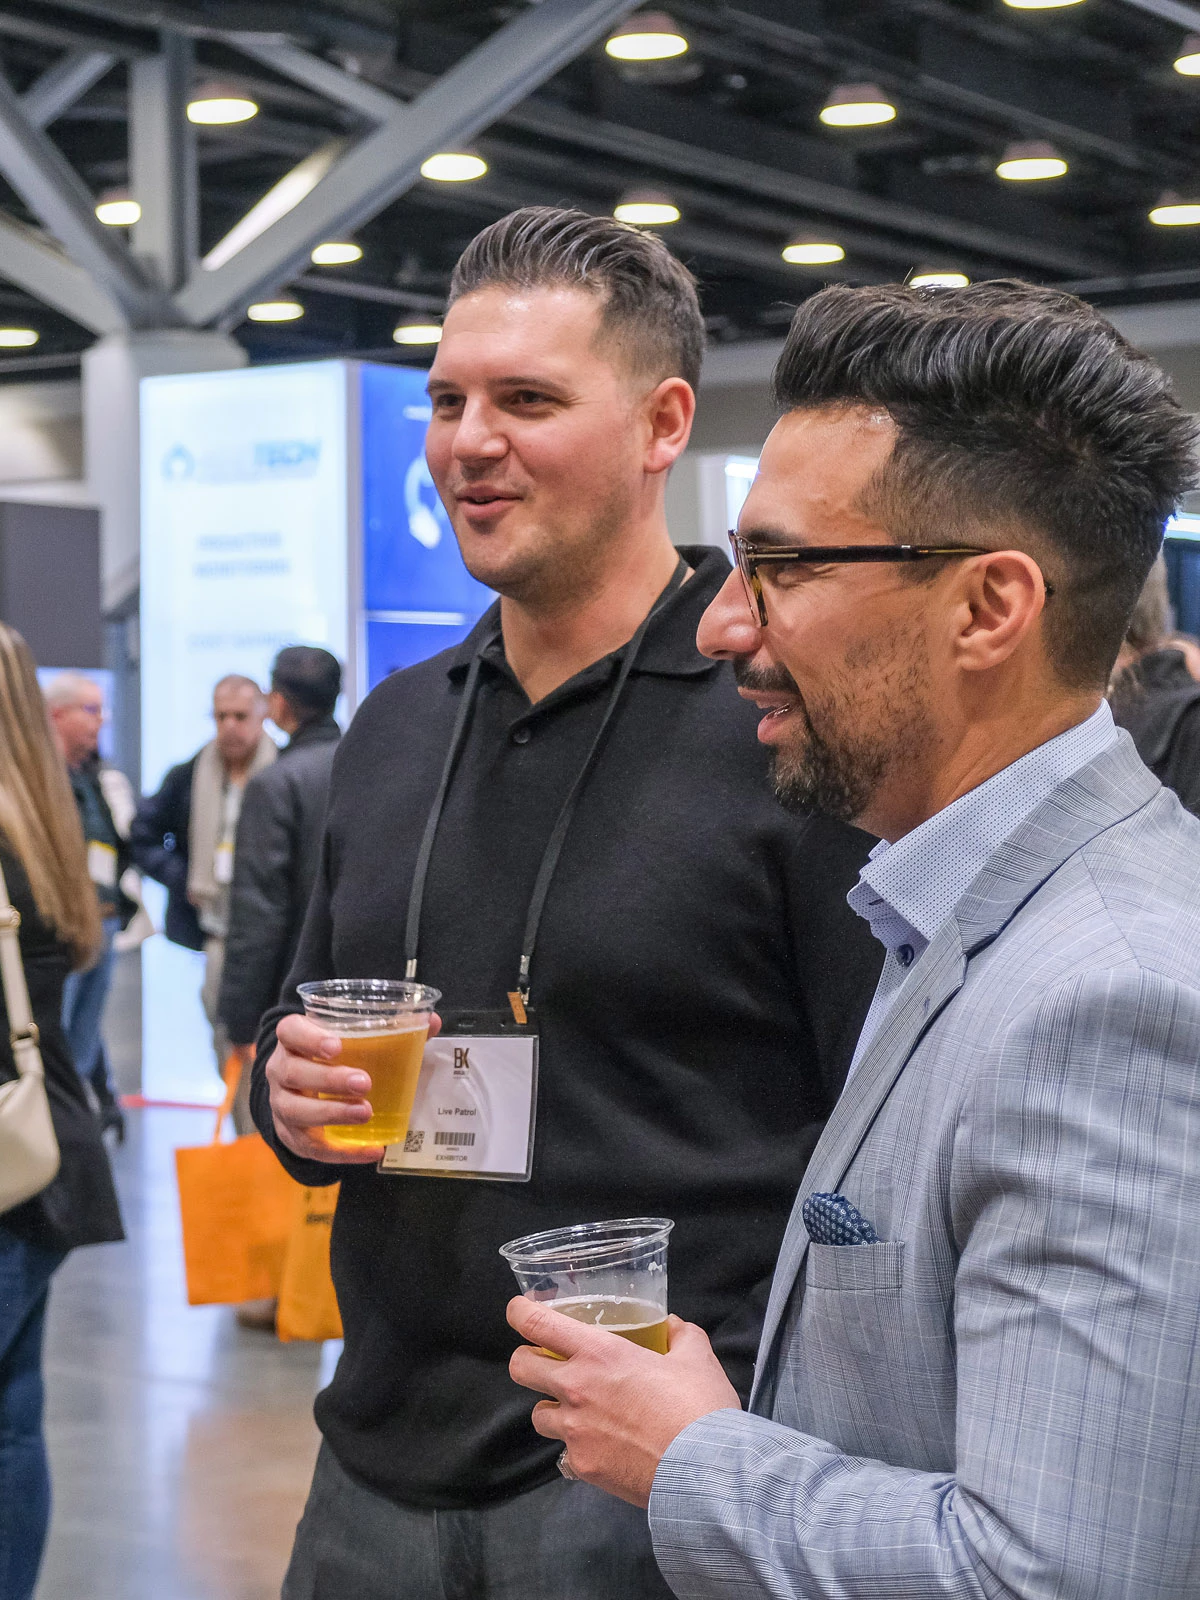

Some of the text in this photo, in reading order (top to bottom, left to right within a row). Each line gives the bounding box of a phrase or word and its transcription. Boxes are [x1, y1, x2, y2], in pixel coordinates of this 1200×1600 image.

[454, 1047, 469, 1068] BK
[437, 1107, 477, 1116] Live Patrol
[436, 1154, 467, 1162] EXHIBITOR
